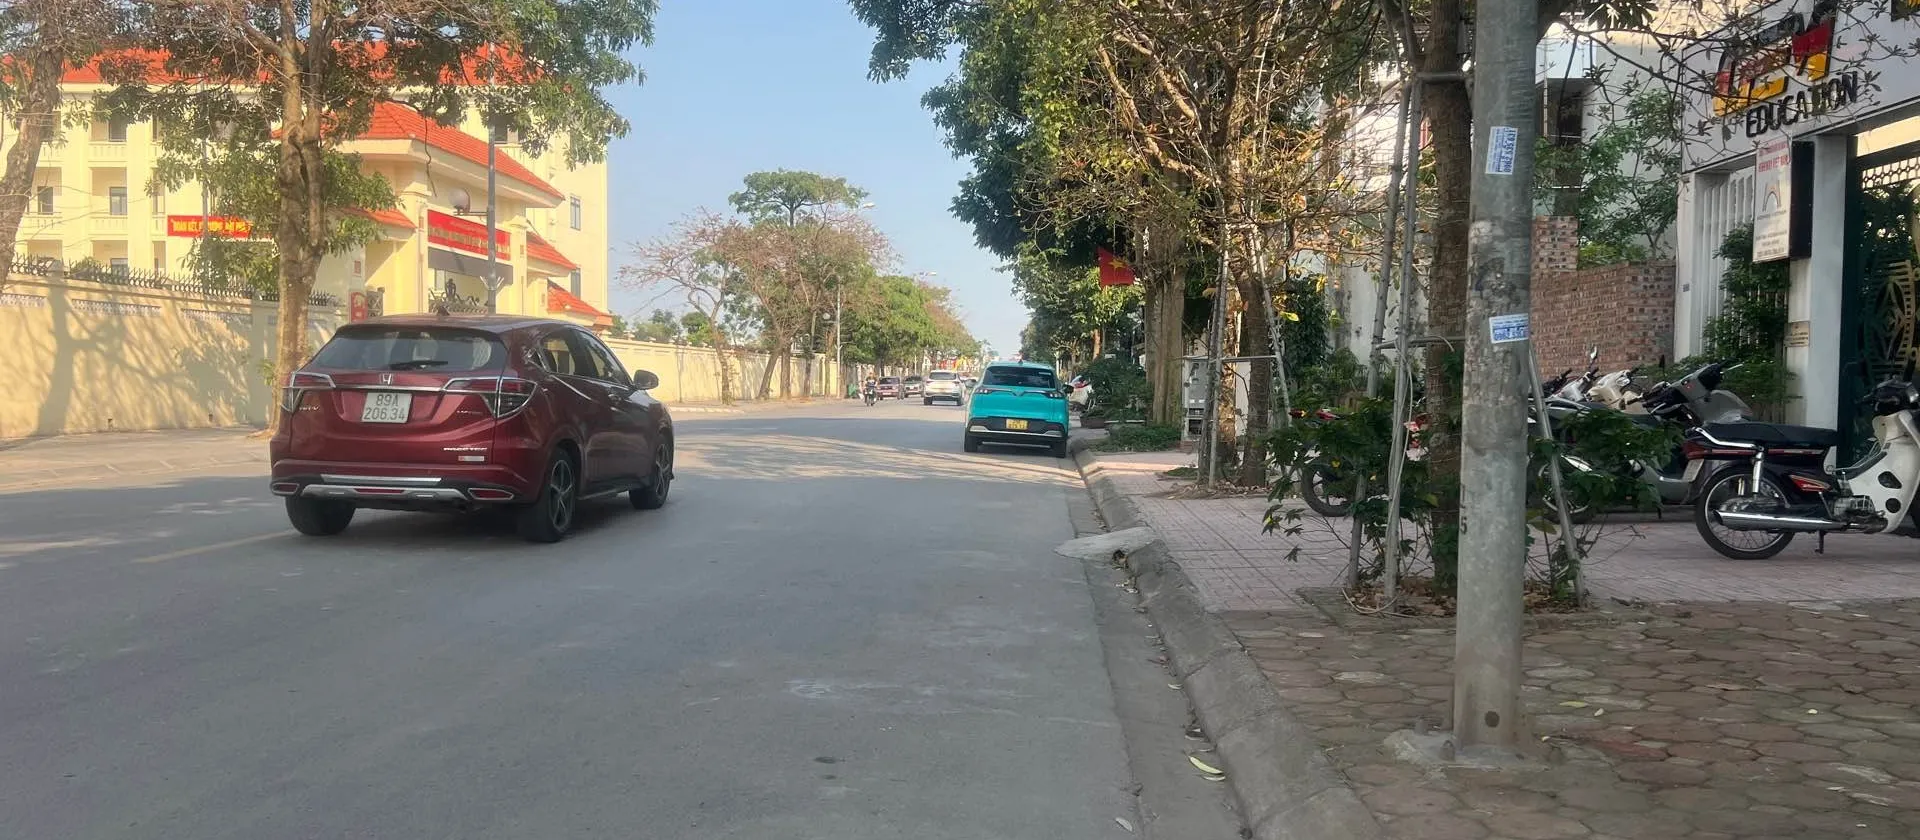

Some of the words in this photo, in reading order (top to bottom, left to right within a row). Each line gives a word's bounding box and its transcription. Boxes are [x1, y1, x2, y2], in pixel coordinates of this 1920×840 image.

[1745, 71, 1858, 138] EDUCATION
[376, 394, 399, 407] 89A
[363, 406, 406, 421] 206.34
